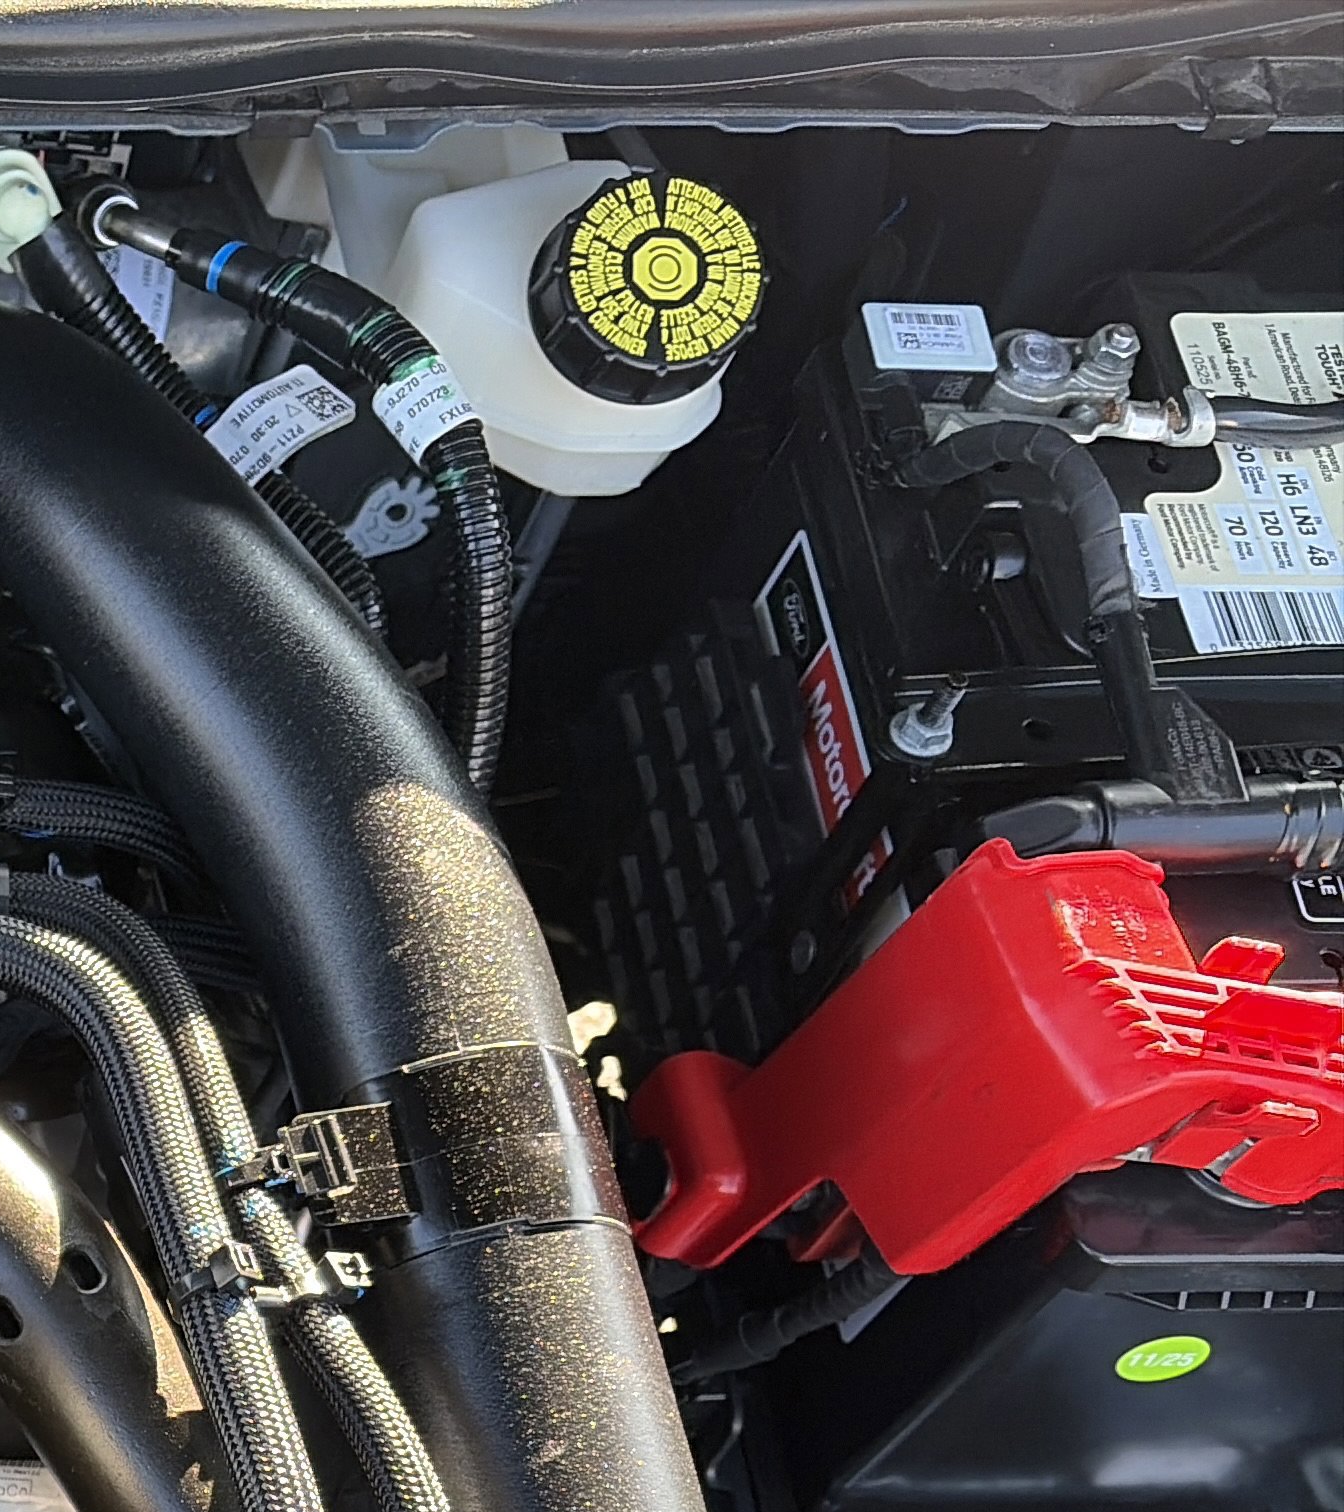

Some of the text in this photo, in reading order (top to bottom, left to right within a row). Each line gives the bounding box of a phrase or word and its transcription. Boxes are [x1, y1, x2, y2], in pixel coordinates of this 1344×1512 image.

[626, 177, 651, 200] DOT
[666, 177, 724, 212] ATTENTION
[585, 192, 620, 225] FLUID
[570, 220, 596, 255] FROM
[664, 211, 720, 254] PROVENANT
[714, 228, 737, 250] QUE
[718, 204, 758, 255] NETTOYER
[569, 256, 587, 267] A
[586, 194, 656, 339] CAP BEFORE REMOVING USE ONLY
[604, 211, 661, 324] WARNING CLEAN FILLER
[722, 249, 741, 264] DU
[742, 255, 761, 270] LE
[569, 269, 598, 313] SEALED
[694, 280, 723, 313] BIDON
[720, 266, 743, 304] LIQUIDE
[731, 271, 761, 322] BOUCHON
[659, 302, 700, 328] SCELLE
[690, 311, 722, 338] FREIN
[712, 300, 732, 318] DE
[587, 310, 648, 358] CONTAINER
[671, 325, 692, 344] DOT
[707, 316, 740, 350] AVANT
[1266, 328, 1287, 364] American
[1187, 343, 1214, 386] 110525
[1280, 332, 1309, 384] Manufactured
[230, 384, 292, 429] AUTOMOTIVE
[380, 363, 447, 420] -9J270-CD
[407, 385, 450, 419] 070723
[1247, 466, 1263, 495] Cranking
[1254, 466, 1267, 482] Cold
[1224, 516, 1248, 538] 70
[1258, 509, 1284, 537] 120
[1277, 473, 1330, 568] H6 LN3 48
[1131, 518, 1163, 593] Made in Germany
[1234, 541, 1246, 561] Hours
[1242, 541, 1254, 557] Amp
[1270, 541, 1286, 570] Capacity
[1279, 541, 1294, 568] Reserve
[1128, 1352, 1197, 1368] 11/25
